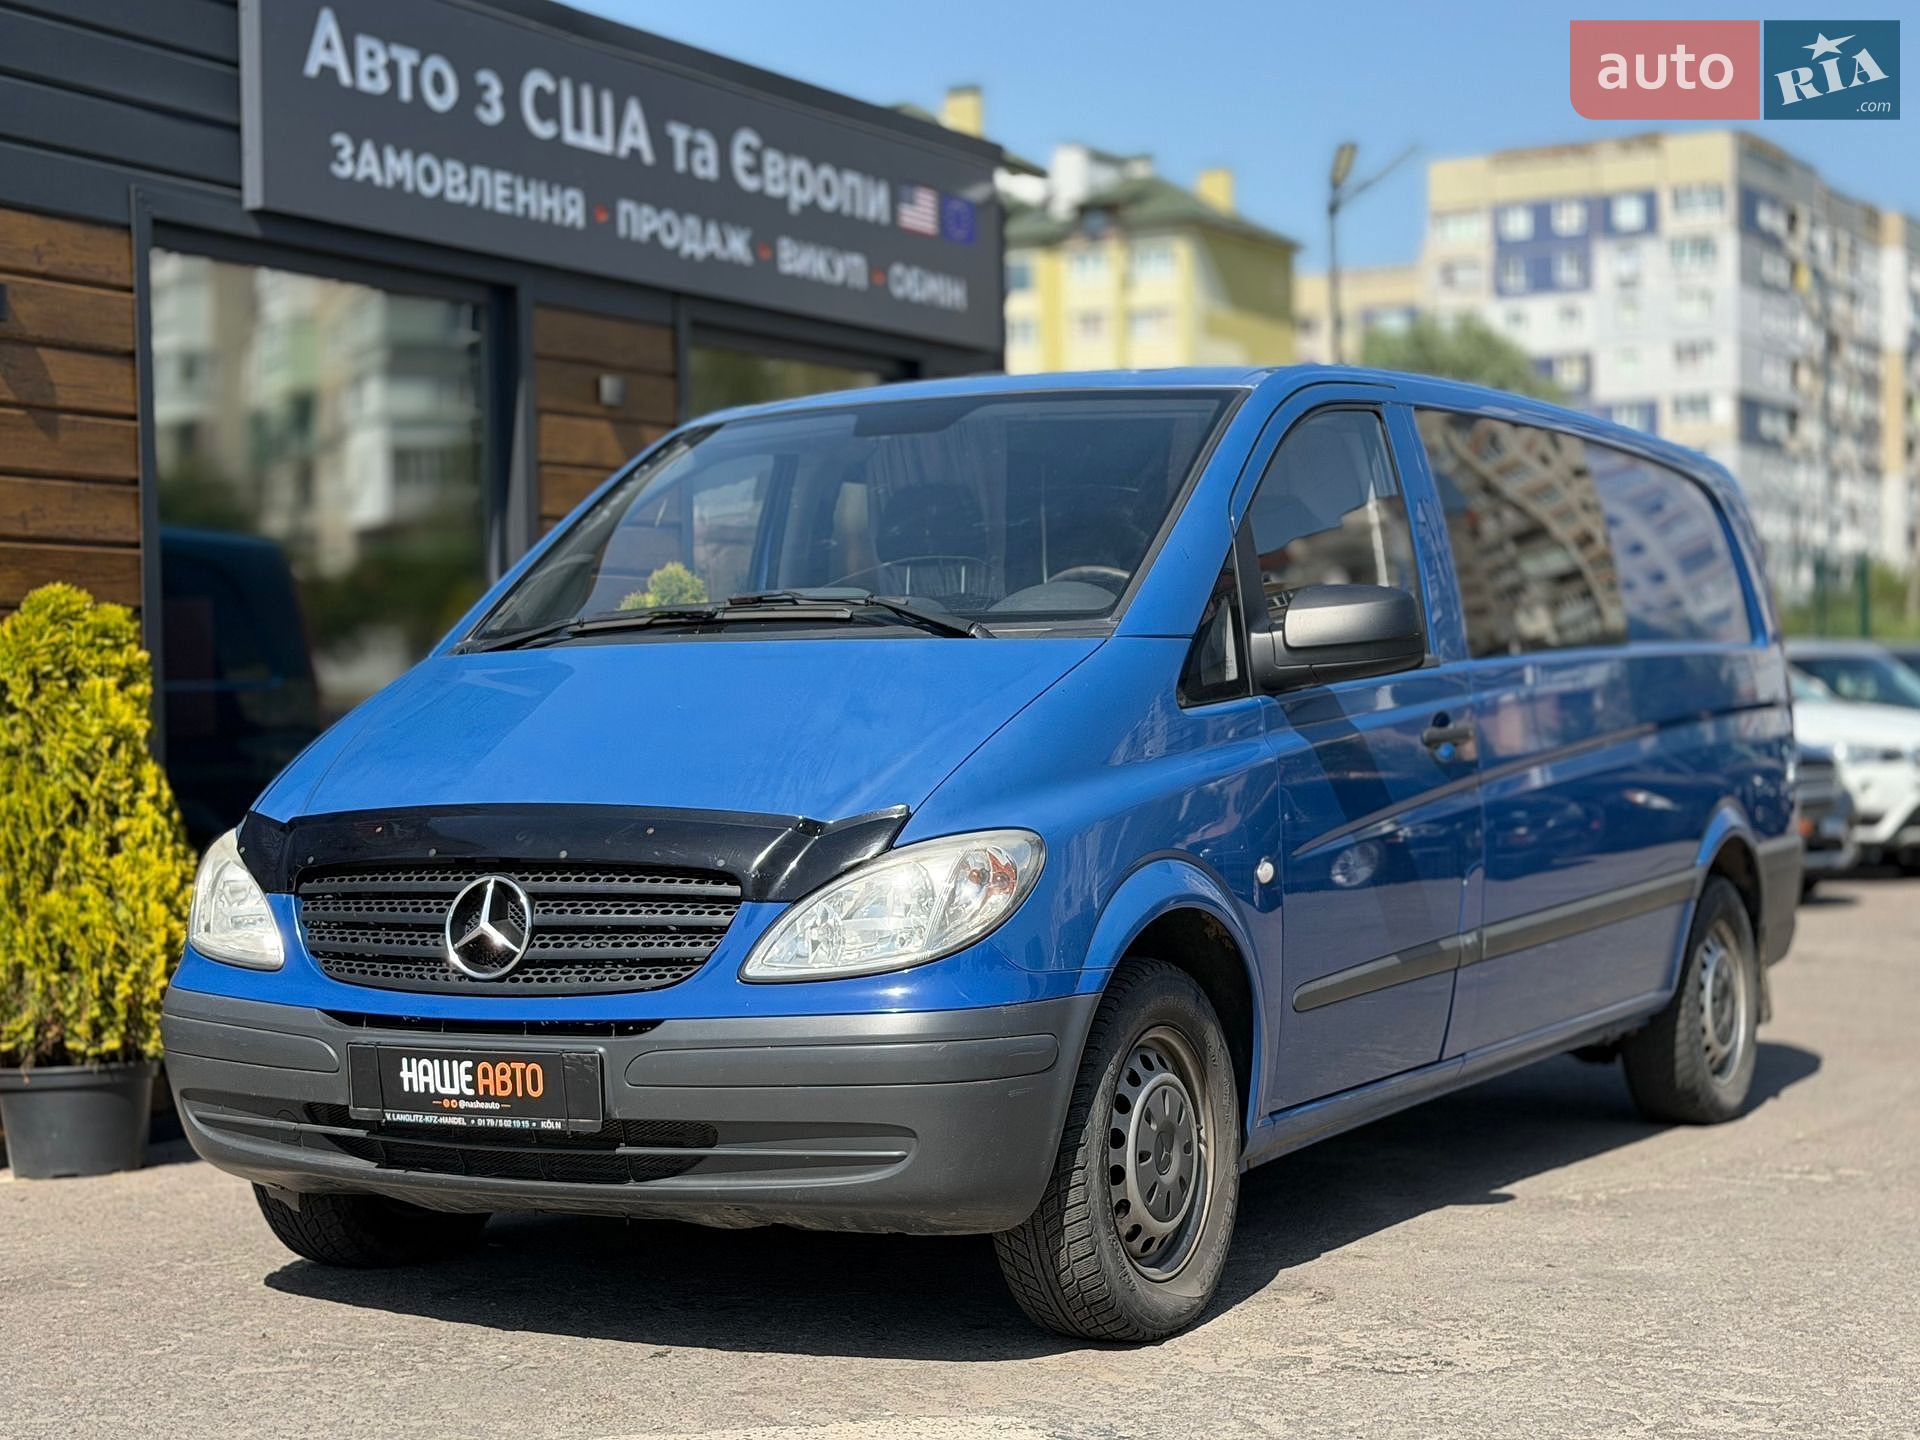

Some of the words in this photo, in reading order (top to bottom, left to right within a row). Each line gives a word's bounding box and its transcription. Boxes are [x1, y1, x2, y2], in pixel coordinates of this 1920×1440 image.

[520, 68, 655, 166] США
[665, 120, 719, 182] та
[730, 127, 892, 226] Європи
[330, 131, 586, 230] ЗАМОВЛЕННЯ
[616, 198, 754, 267] ПРОДАЖ
[776, 235, 869, 291] ВИКУП
[888, 262, 968, 312] ОБМІН
[459, 1099, 501, 1110] @nasheauto
[541, 1119, 562, 1129] KÖLN
